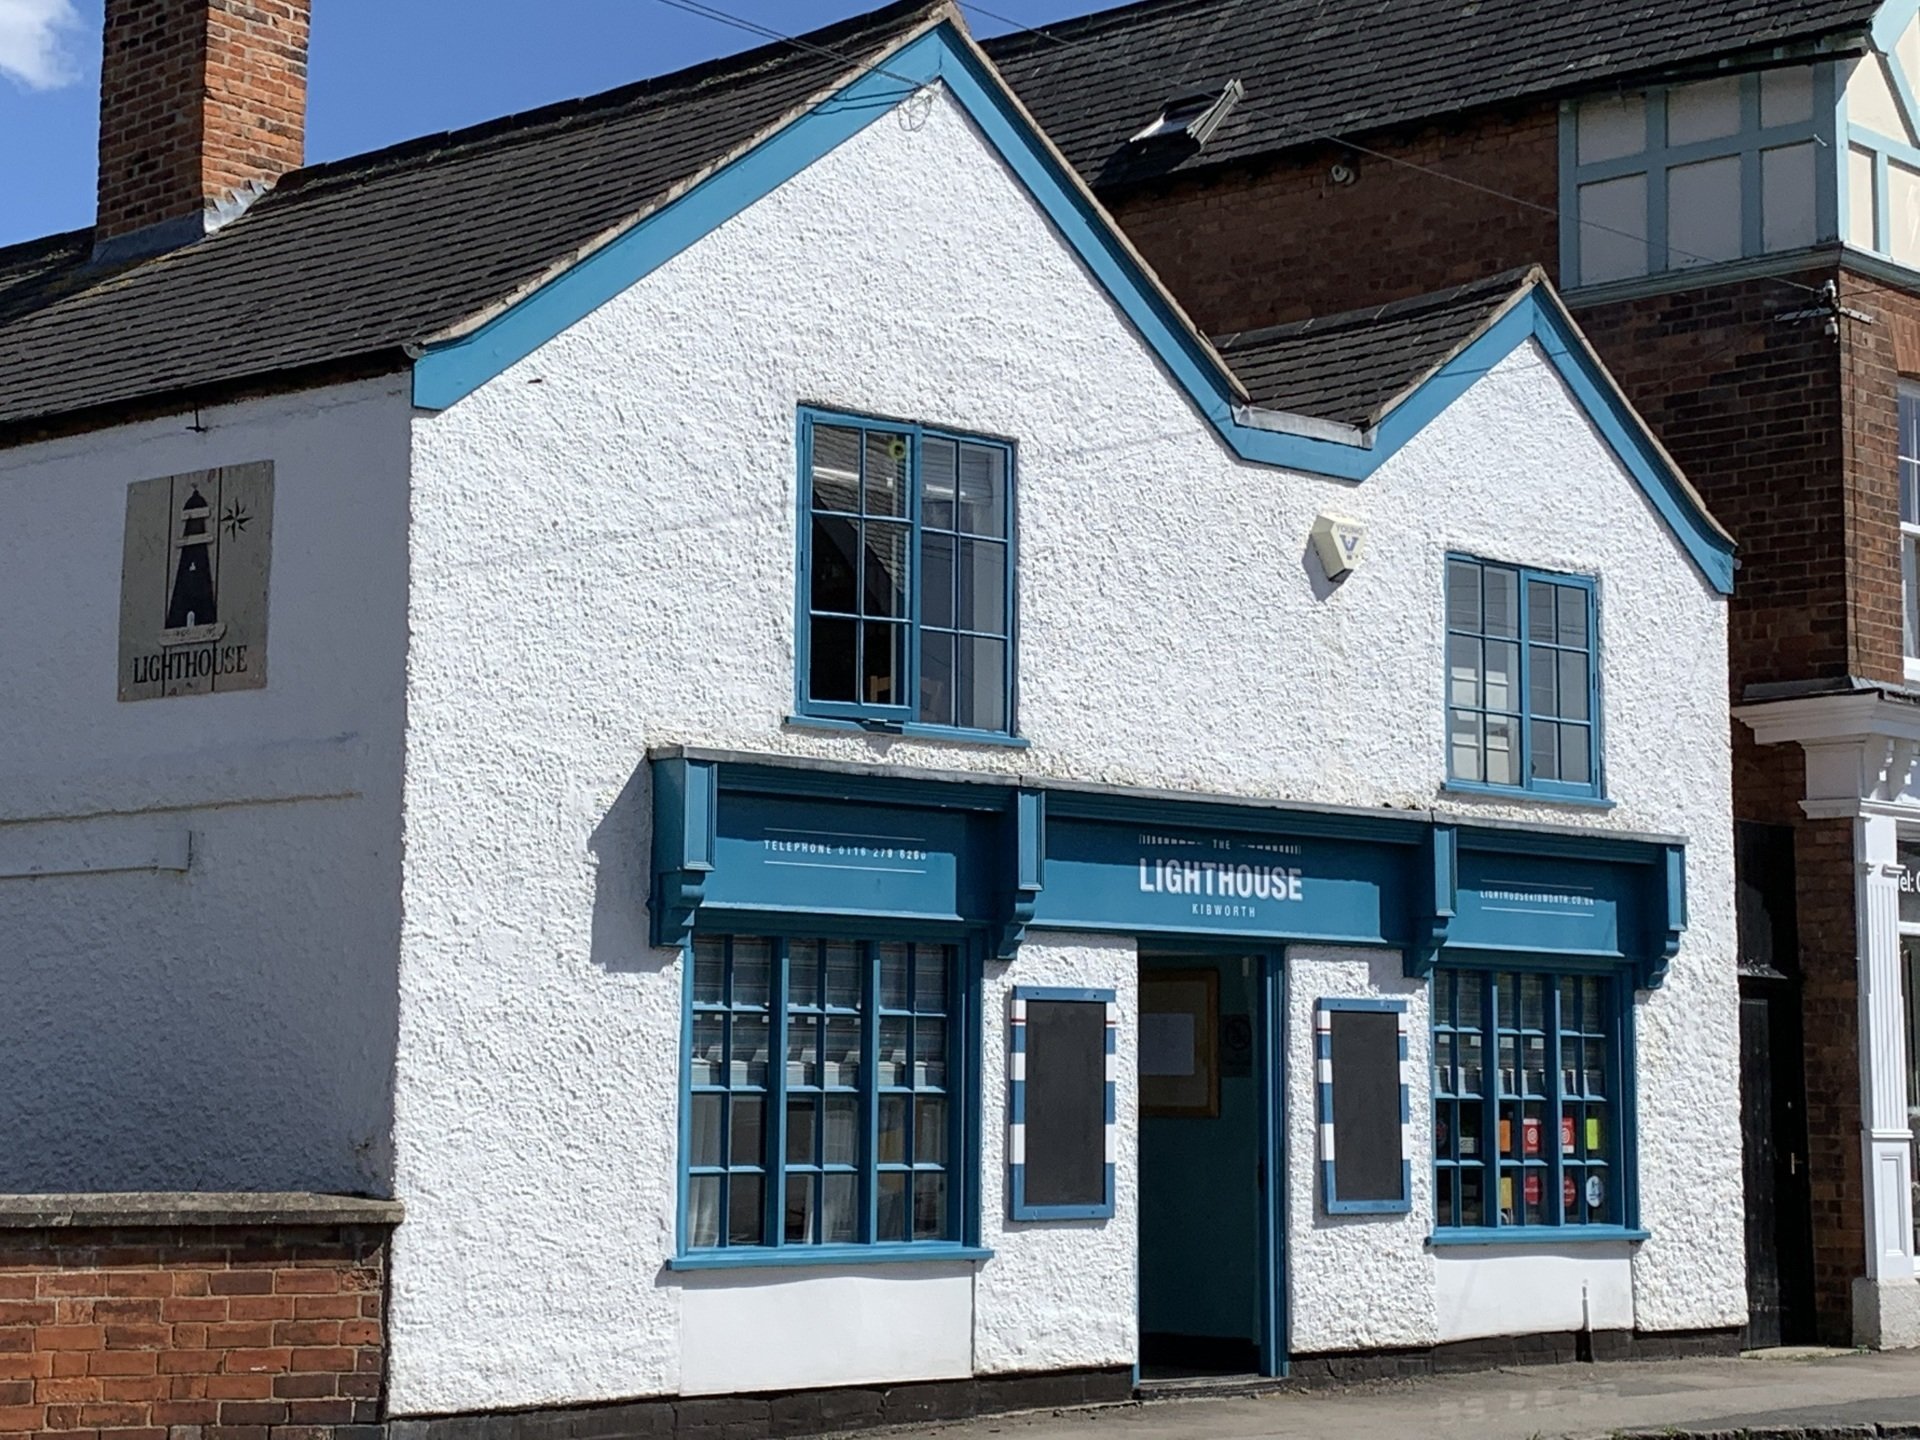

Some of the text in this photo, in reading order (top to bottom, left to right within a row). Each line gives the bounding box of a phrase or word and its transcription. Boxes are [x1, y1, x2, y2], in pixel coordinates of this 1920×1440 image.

[134, 645, 247, 684] LIGHTHOUSE
[764, 839, 832, 855] TELEPHONE
[1213, 839, 1231, 850] THE
[1139, 858, 1303, 900] LIGHTHOUSE
[1192, 903, 1256, 918] KIBWORTH
